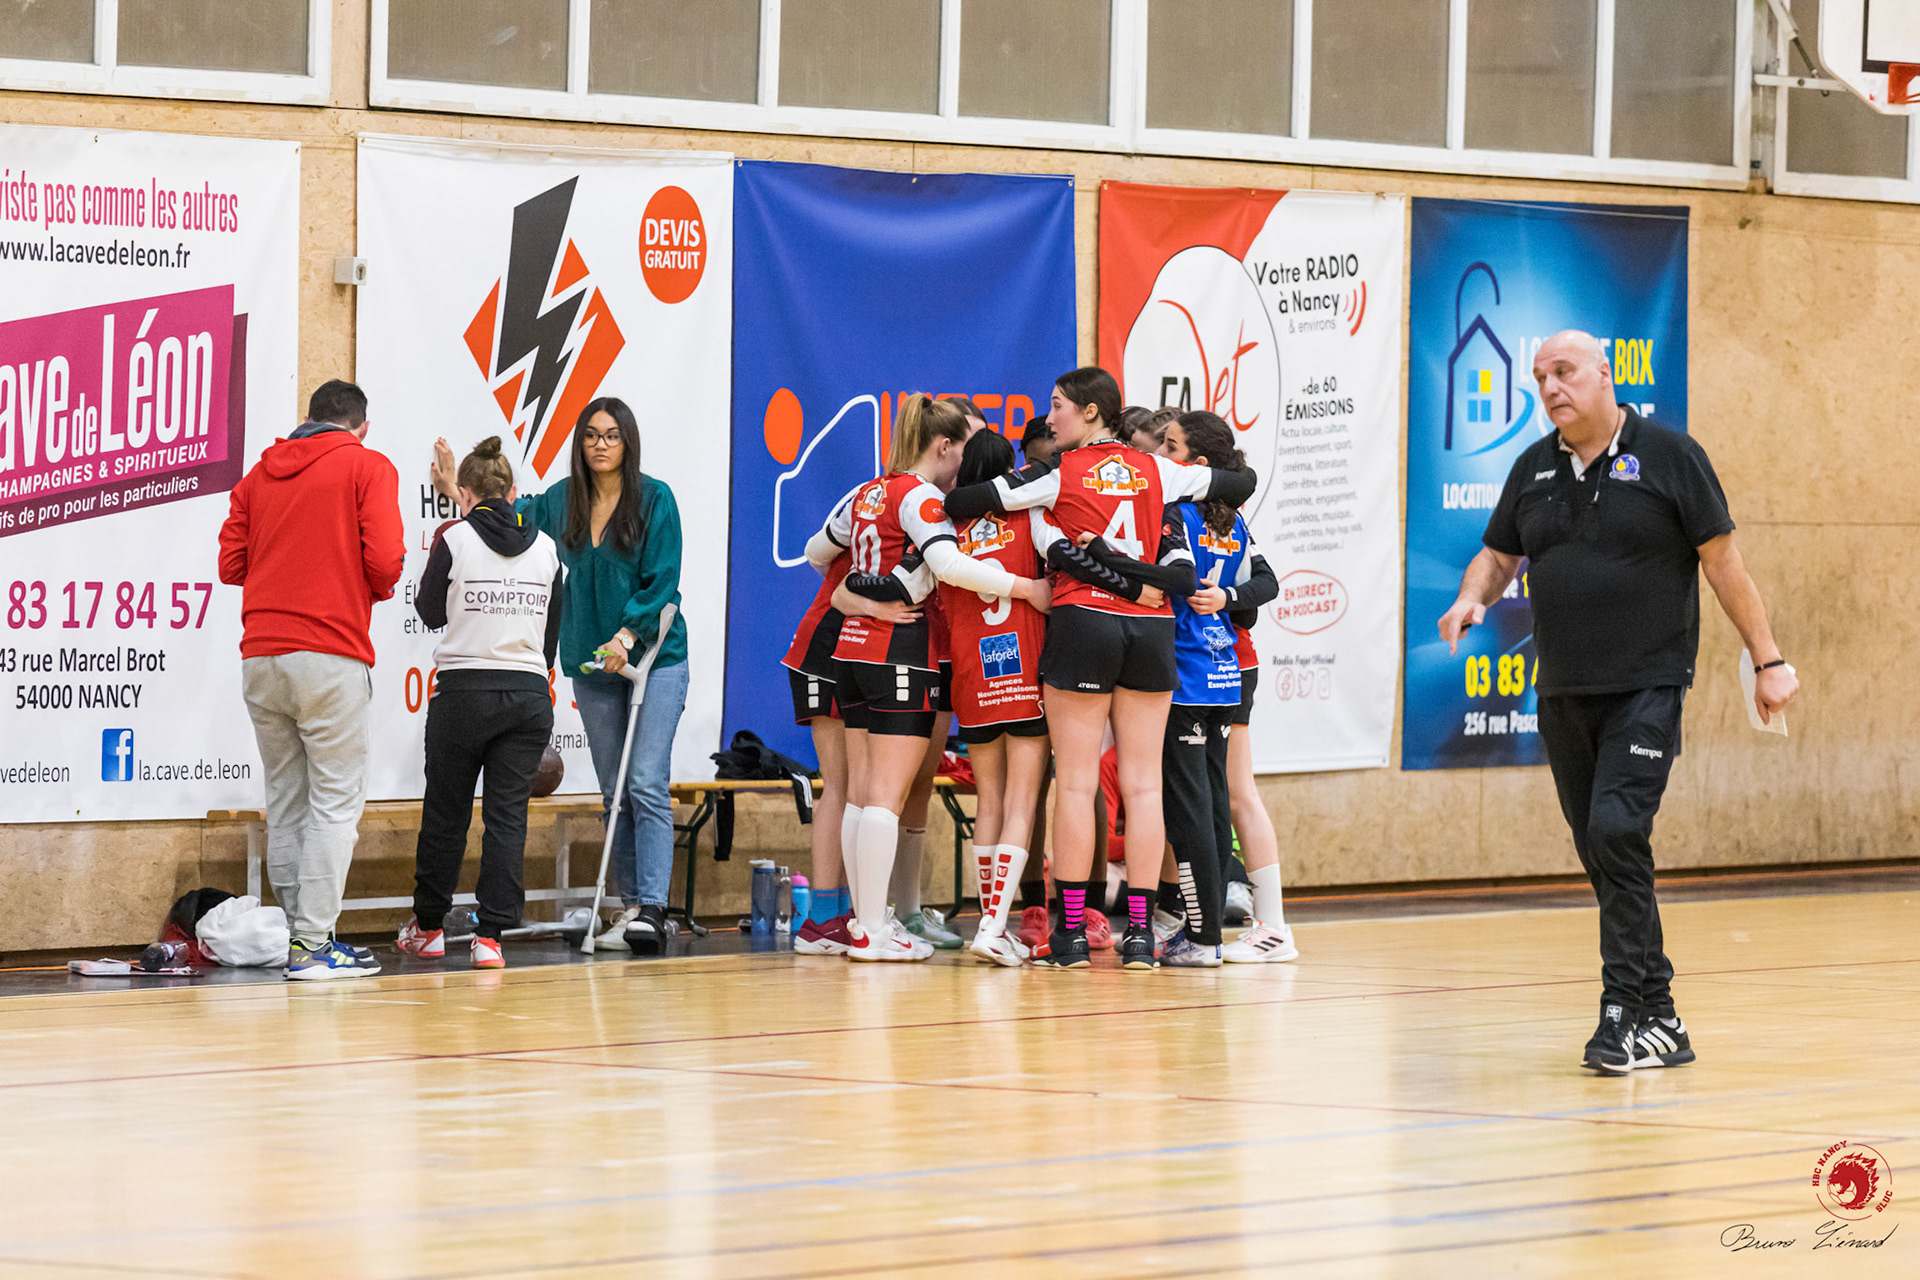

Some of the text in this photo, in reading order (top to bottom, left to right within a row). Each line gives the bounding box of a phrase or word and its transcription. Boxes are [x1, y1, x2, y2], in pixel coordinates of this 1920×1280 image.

[44, 183, 76, 231] pas
[82, 184, 145, 228] comme
[152, 177, 176, 229] les
[183, 181, 238, 233] autres
[645, 218, 700, 247] DEVIS
[645, 249, 701, 269] GRATUIT
[1254, 253, 1358, 286] Votre RADIO
[1279, 290, 1340, 316] à Nancy
[1298, 319, 1336, 333] environs
[1614, 338, 1655, 385] BOX
[71, 392, 97, 458] de
[100, 308, 213, 453] Léon
[1323, 376, 1337, 393] 60
[1285, 393, 1354, 421] ÉMISSIONS
[99, 460, 108, 479] &
[114, 441, 208, 475] SPIRITUEUX
[19, 506, 35, 525] de
[38, 503, 60, 525] pro
[64, 496, 96, 519] pour
[100, 490, 119, 508] les
[124, 475, 199, 507] particuliers
[1102, 500, 1145, 561] 4
[503, 578, 516, 587] LE
[1284, 582, 1333, 602] EN DIRECT
[7, 580, 213, 630] 83 17 84 57
[464, 590, 548, 608] COMPTOIR
[482, 605, 535, 617] Campanile
[1277, 599, 1338, 620] EN PODCAST
[404, 616, 418, 634] et
[22, 653, 53, 673] rue
[60, 646, 121, 672] Marcel
[127, 648, 166, 672] Brot
[982, 647, 1019, 664] laforêt
[1272, 655, 1293, 666] Radio
[989, 678, 1023, 689] Agences
[1465, 655, 1491, 698] 03
[1497, 654, 1525, 697] 83
[16, 684, 142, 709] 54000 NANCY
[977, 685, 1039, 699] Neuves-Maisons
[1464, 711, 1488, 736] 256
[1489, 714, 1508, 736] rue
[1630, 744, 1663, 760] Kempa
[138, 758, 251, 781] la.cave.de.leon
